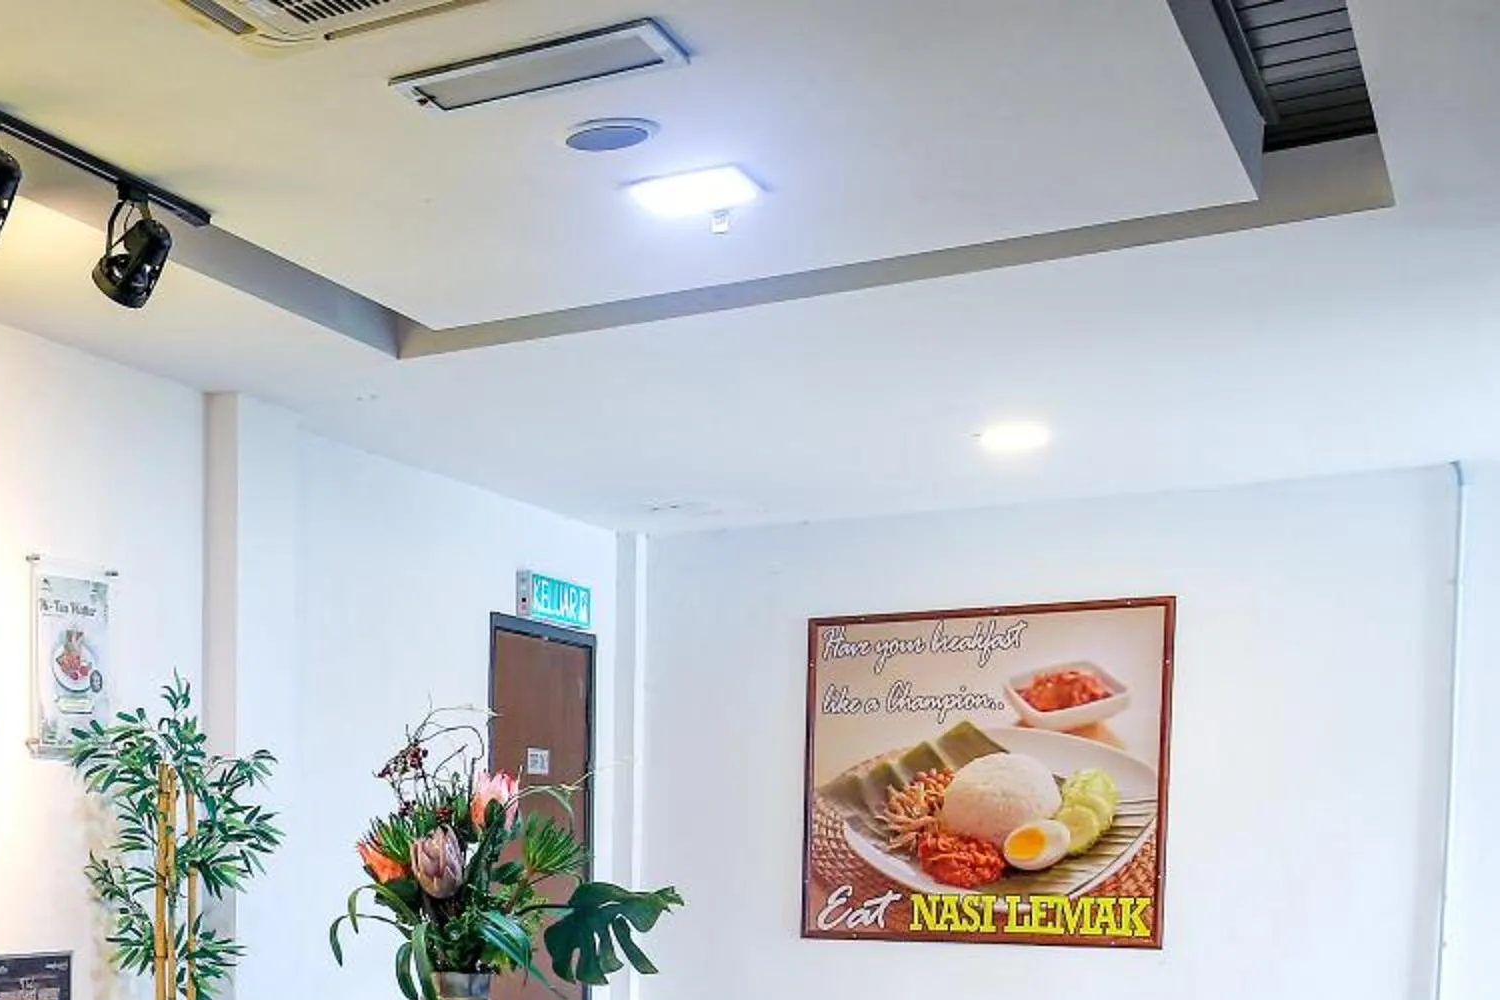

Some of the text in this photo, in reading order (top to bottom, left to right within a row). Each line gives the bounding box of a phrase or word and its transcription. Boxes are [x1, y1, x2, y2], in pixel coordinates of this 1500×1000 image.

[822, 620, 1028, 675] Have your breakfast
[822, 683, 861, 714] like
[863, 697, 880, 713] a
[817, 886, 1152, 937] Eat NASI LEMAK
